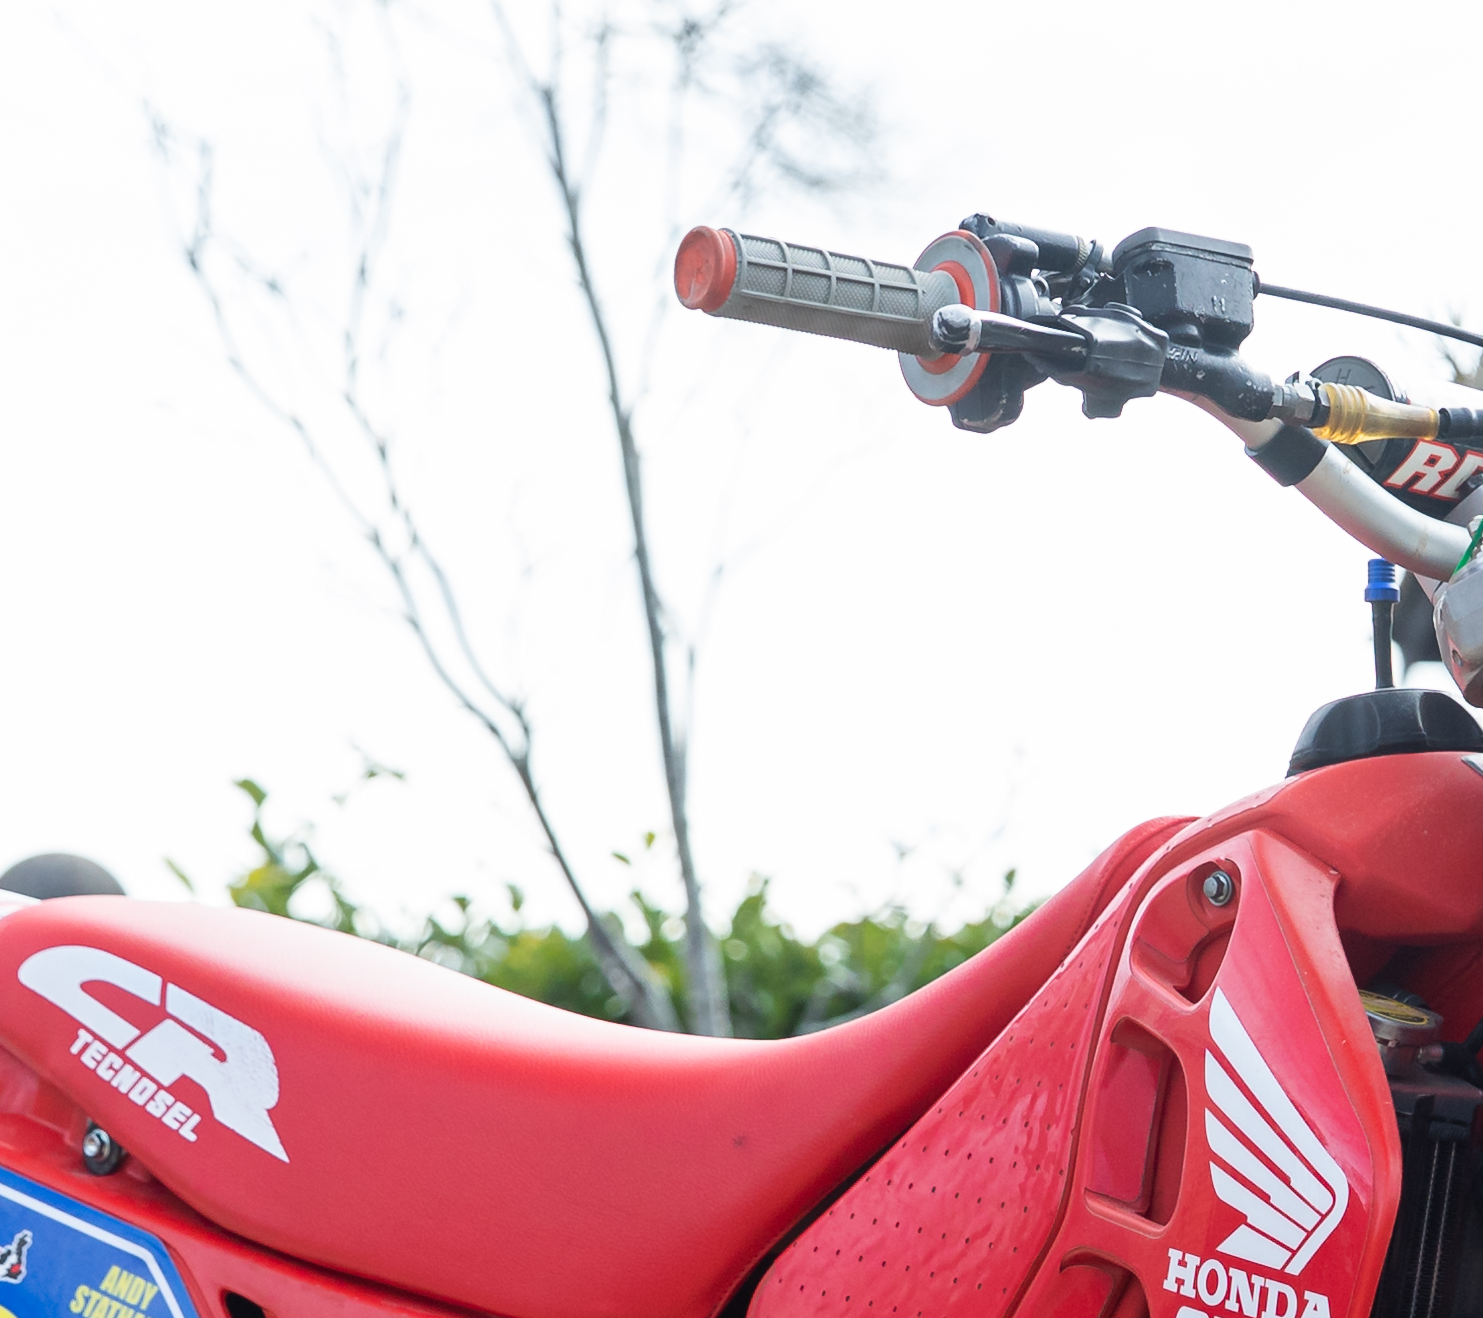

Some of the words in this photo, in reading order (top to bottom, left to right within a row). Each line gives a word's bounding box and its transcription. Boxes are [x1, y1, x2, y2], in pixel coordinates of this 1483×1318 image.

[17, 944, 291, 1164] CR
[69, 1028, 199, 1143] TECNOSEL
[99, 1264, 160, 1311] ANDY
